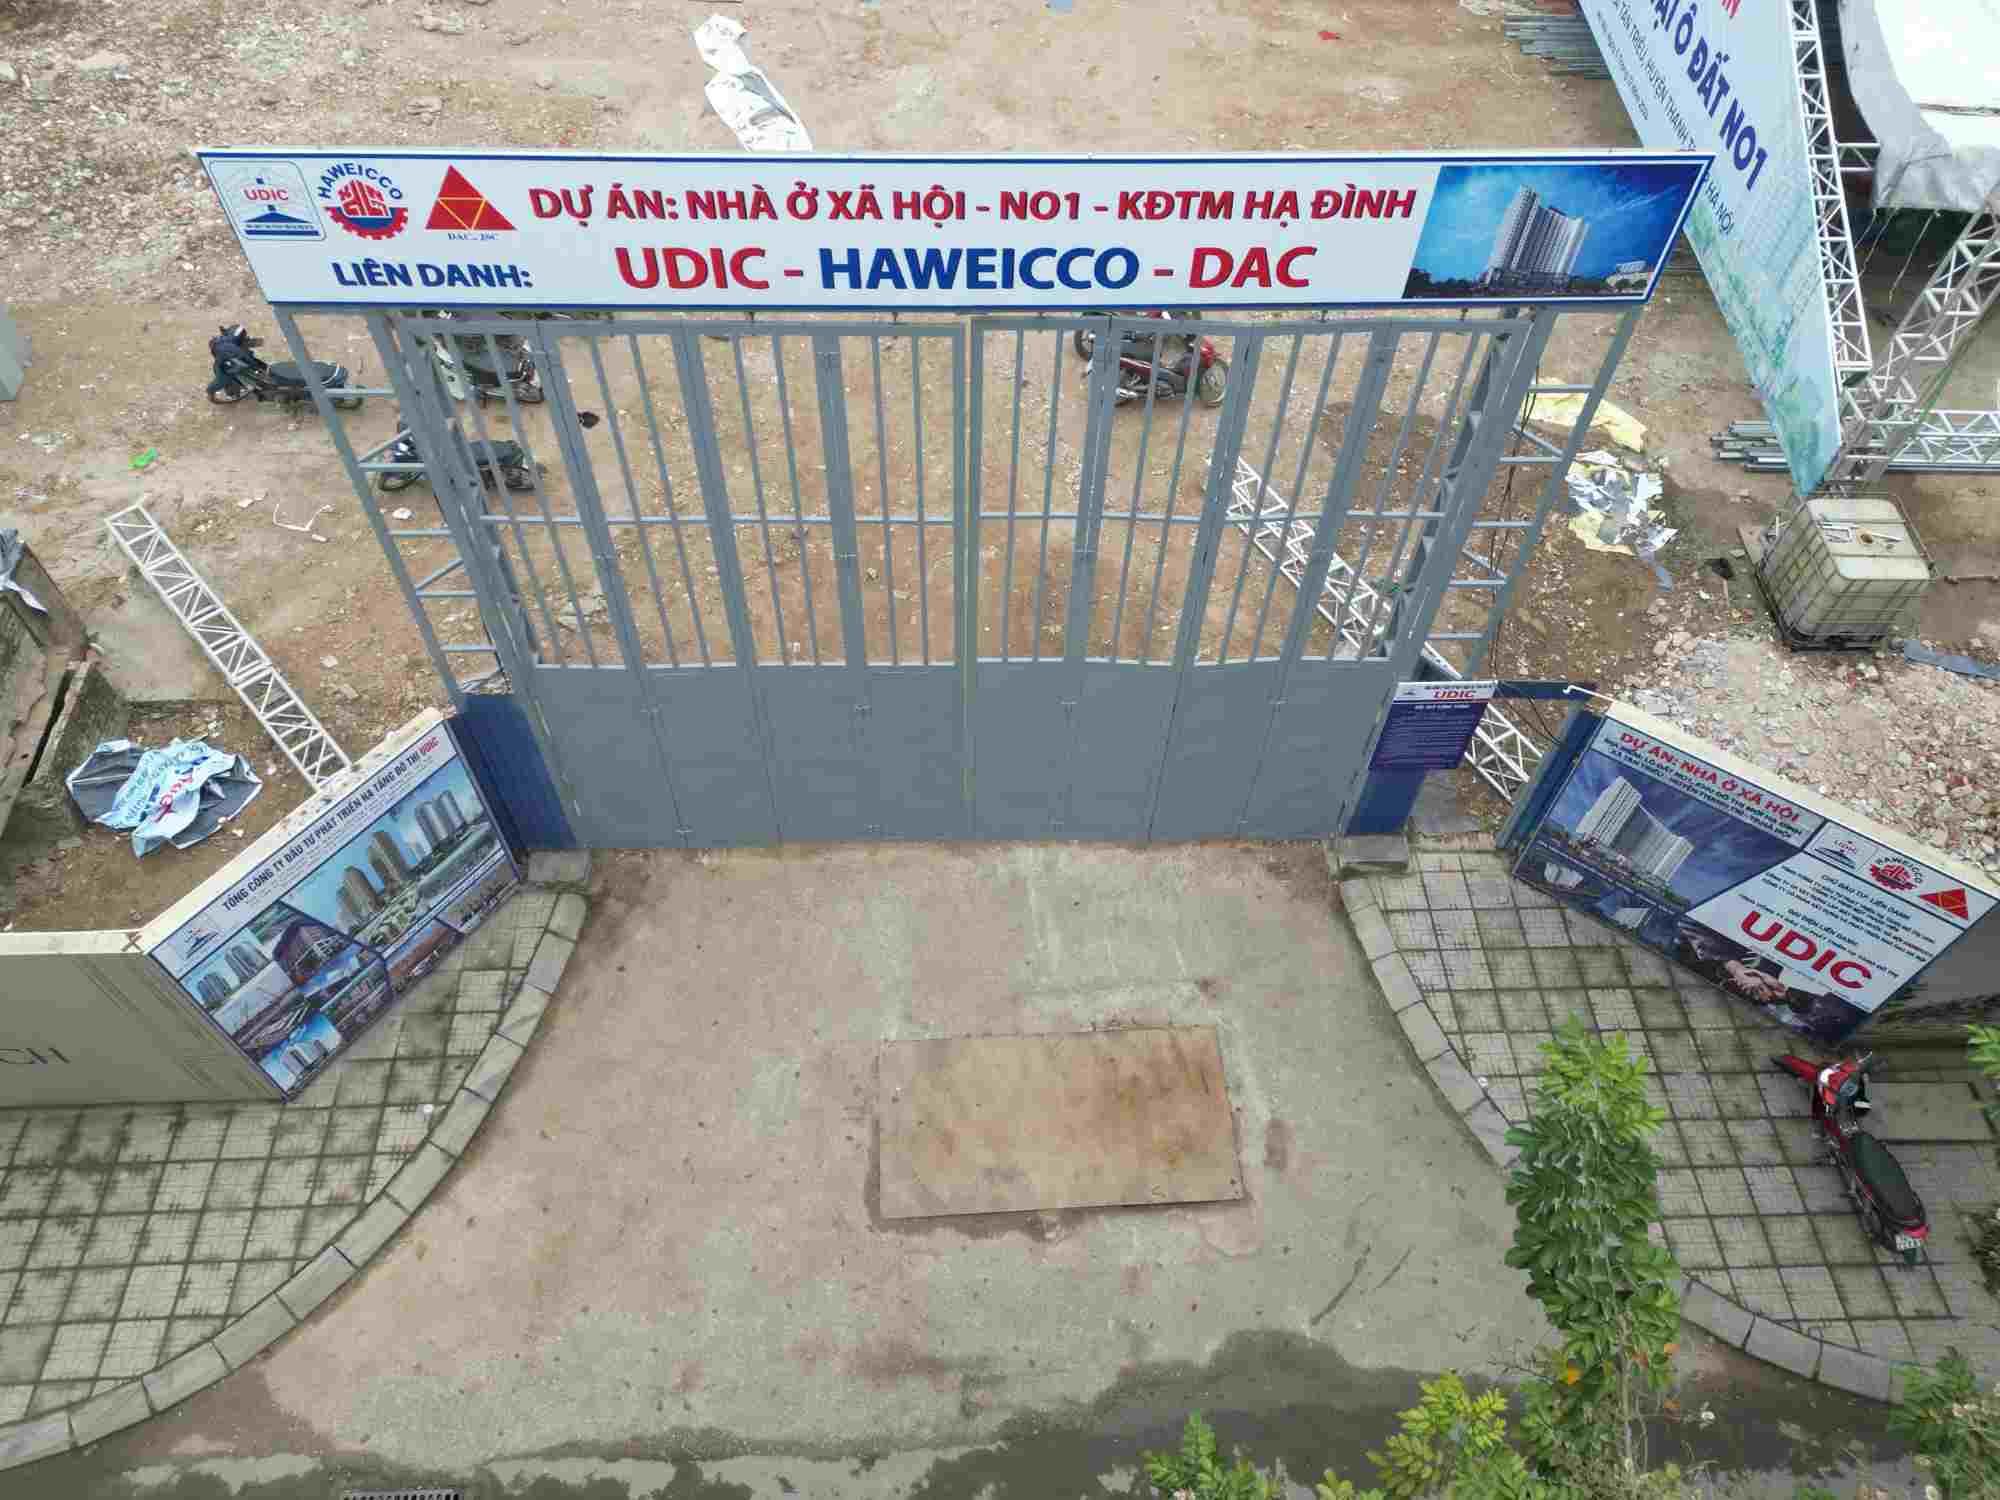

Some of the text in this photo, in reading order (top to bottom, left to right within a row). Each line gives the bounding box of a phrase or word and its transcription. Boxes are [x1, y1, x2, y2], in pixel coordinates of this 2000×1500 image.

[1687, 36, 1730, 119] ĐẤT
[243, 187, 289, 202] UDIC
[318, 163, 403, 201] HAWEICCO
[528, 185, 594, 228] DỰ
[607, 183, 679, 220] ÁN:
[685, 184, 779, 220] NHÀ
[786, 181, 819, 221] Ở
[826, 183, 883, 220] XÃ
[892, 184, 966, 228] HỘI
[1117, 190, 1234, 221] KĐTM
[1242, 190, 1301, 229] HẠ
[1310, 184, 1417, 221] ĐÌNH
[331, 257, 534, 289] LIÊN DANH:
[614, 247, 770, 290] UDIC
[818, 247, 1140, 290] HAWEICCO
[1189, 246, 1319, 289] DAC
[1621, 732, 1649, 752] DỰ
[248, 867, 275, 894] CÔNG
[273, 857, 286, 878] TY
[1741, 910, 1872, 989] UDIC
